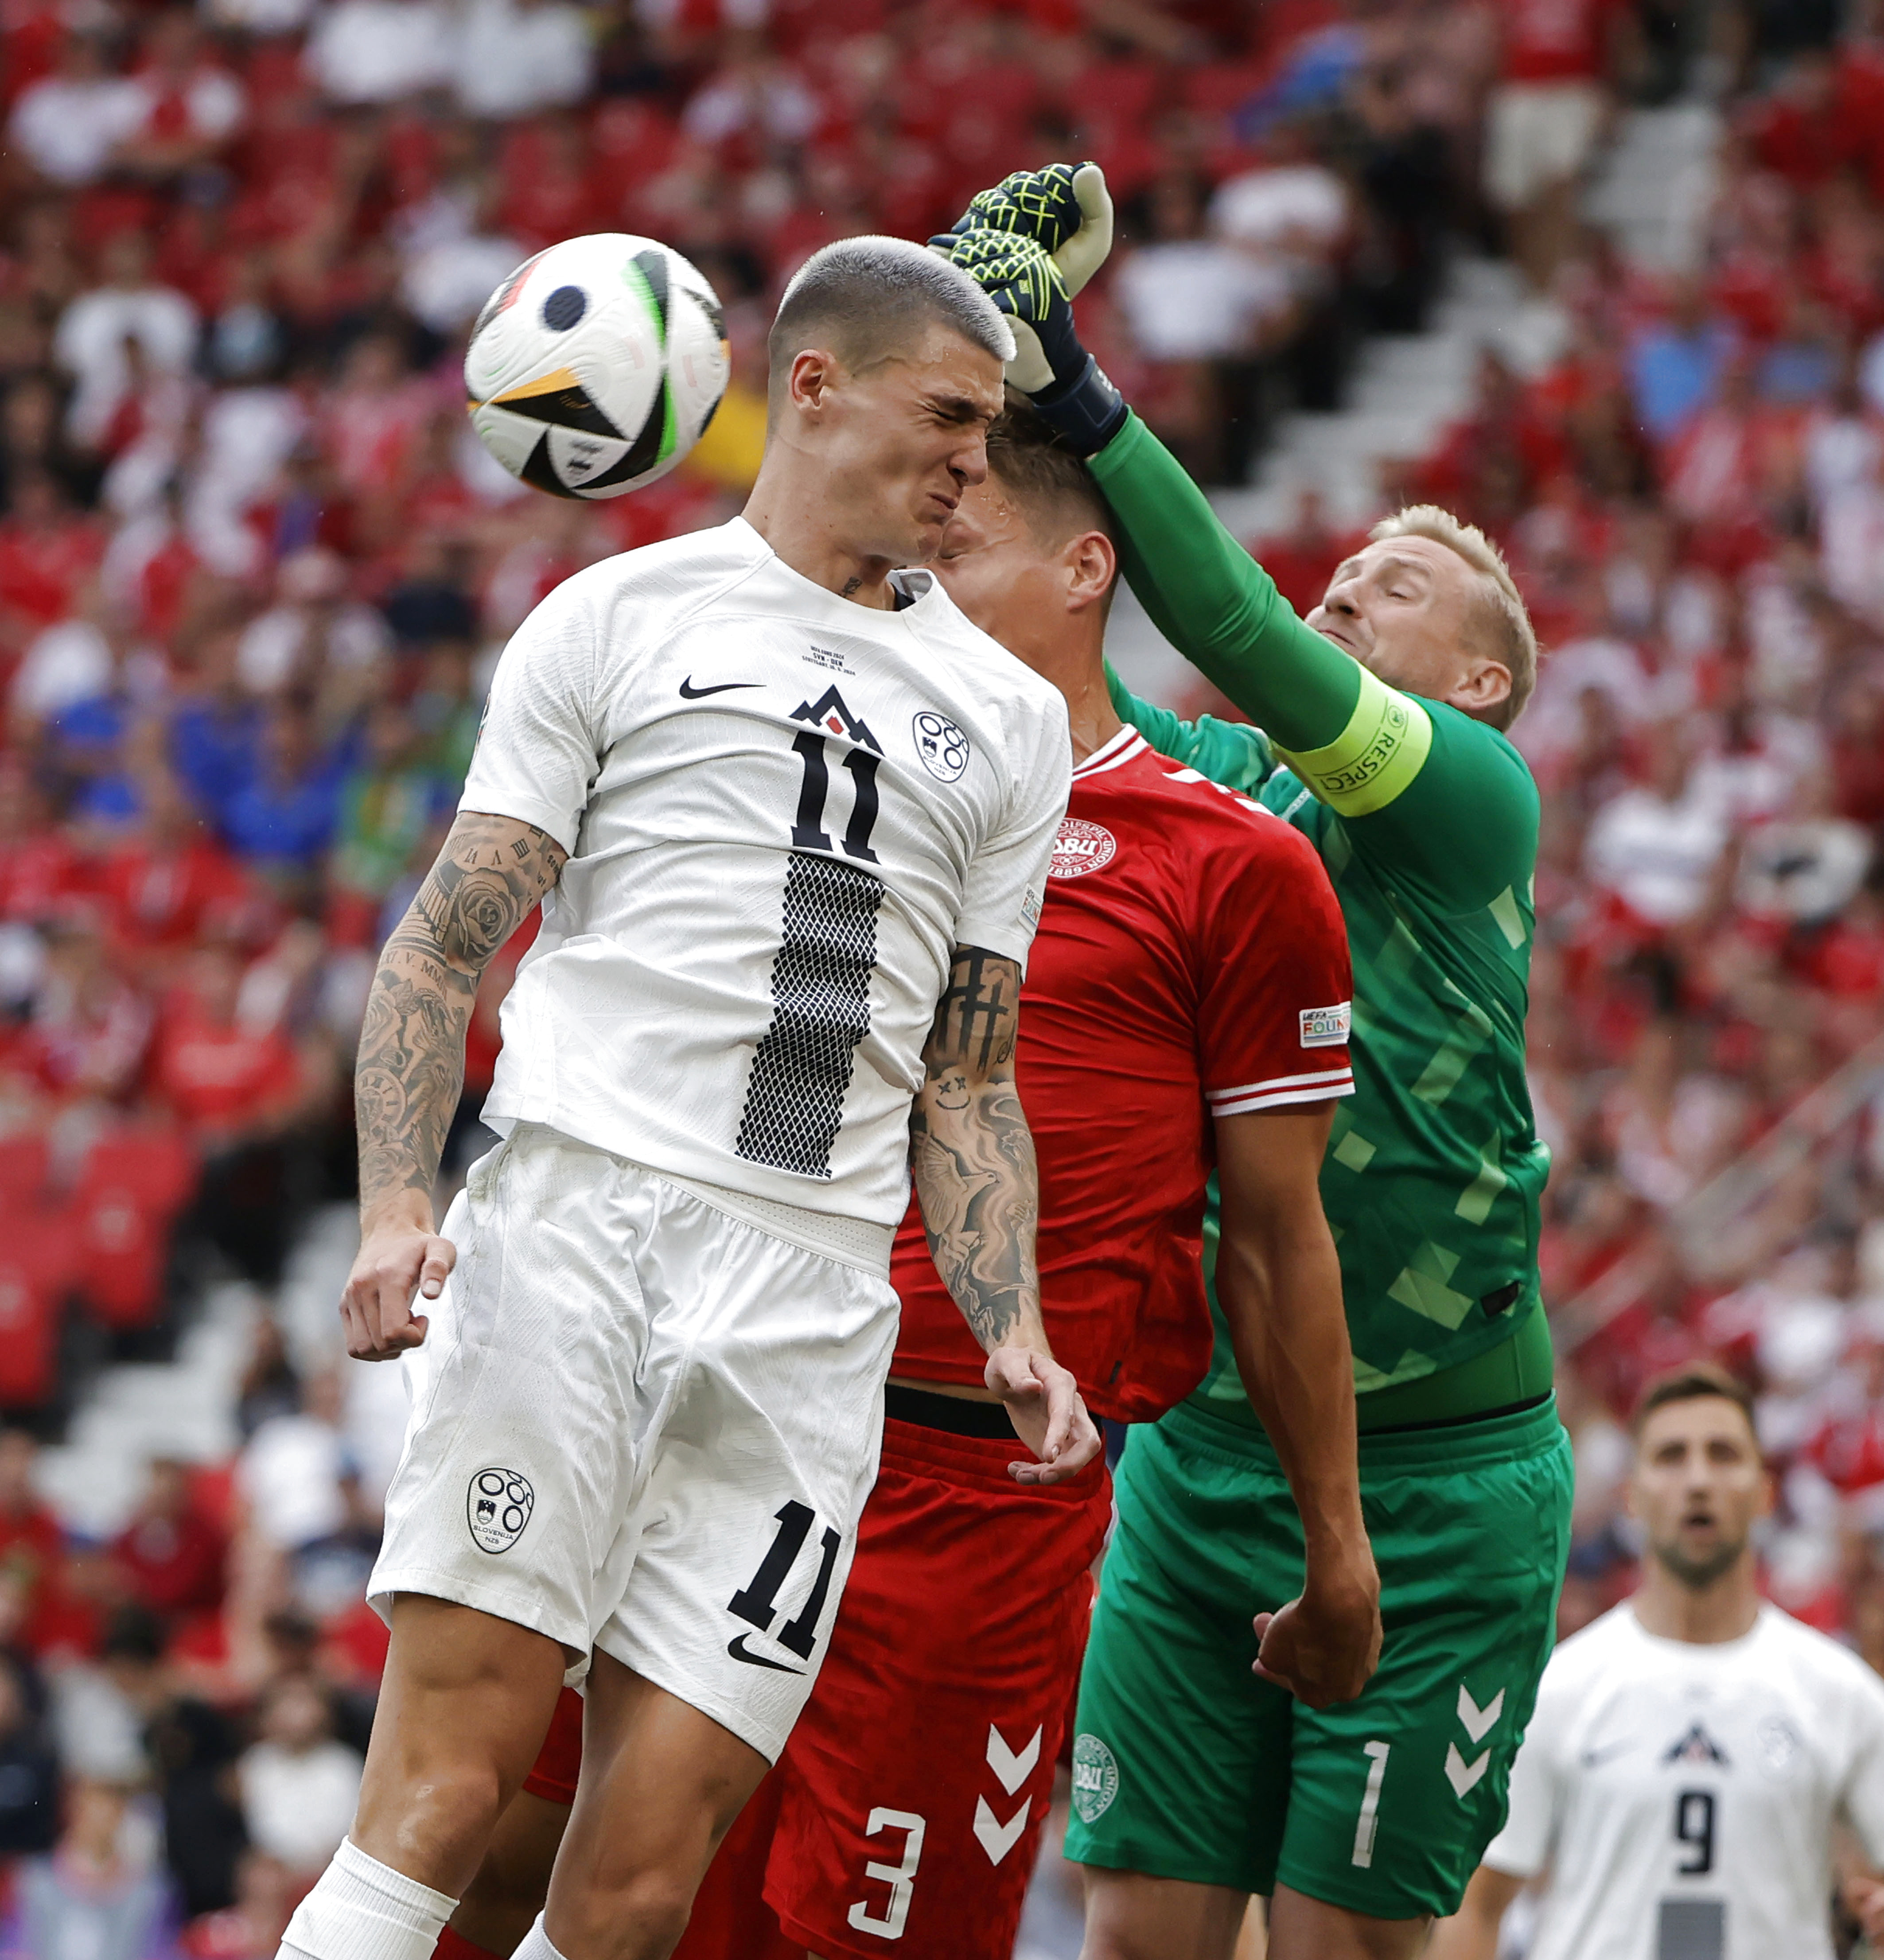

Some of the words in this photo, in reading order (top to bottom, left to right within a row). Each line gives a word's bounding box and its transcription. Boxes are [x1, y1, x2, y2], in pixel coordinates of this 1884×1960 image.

[813, 653, 825, 662] SVN
[830, 658, 843, 667] DEN
[1320, 732, 1396, 790] RESPECT
[790, 730, 881, 865] 11
[1048, 866, 1082, 876] 1889
[1086, 840, 1113, 869] UNION
[1303, 1011, 1327, 1021] UEFA
[473, 1524, 514, 1540] SLOVENIJA
[485, 1536, 500, 1545] NZS
[726, 1499, 841, 1662] 11
[1351, 1740, 1390, 1868] 1
[1676, 1790, 1715, 1875] 9
[847, 1806, 926, 1940] 3
